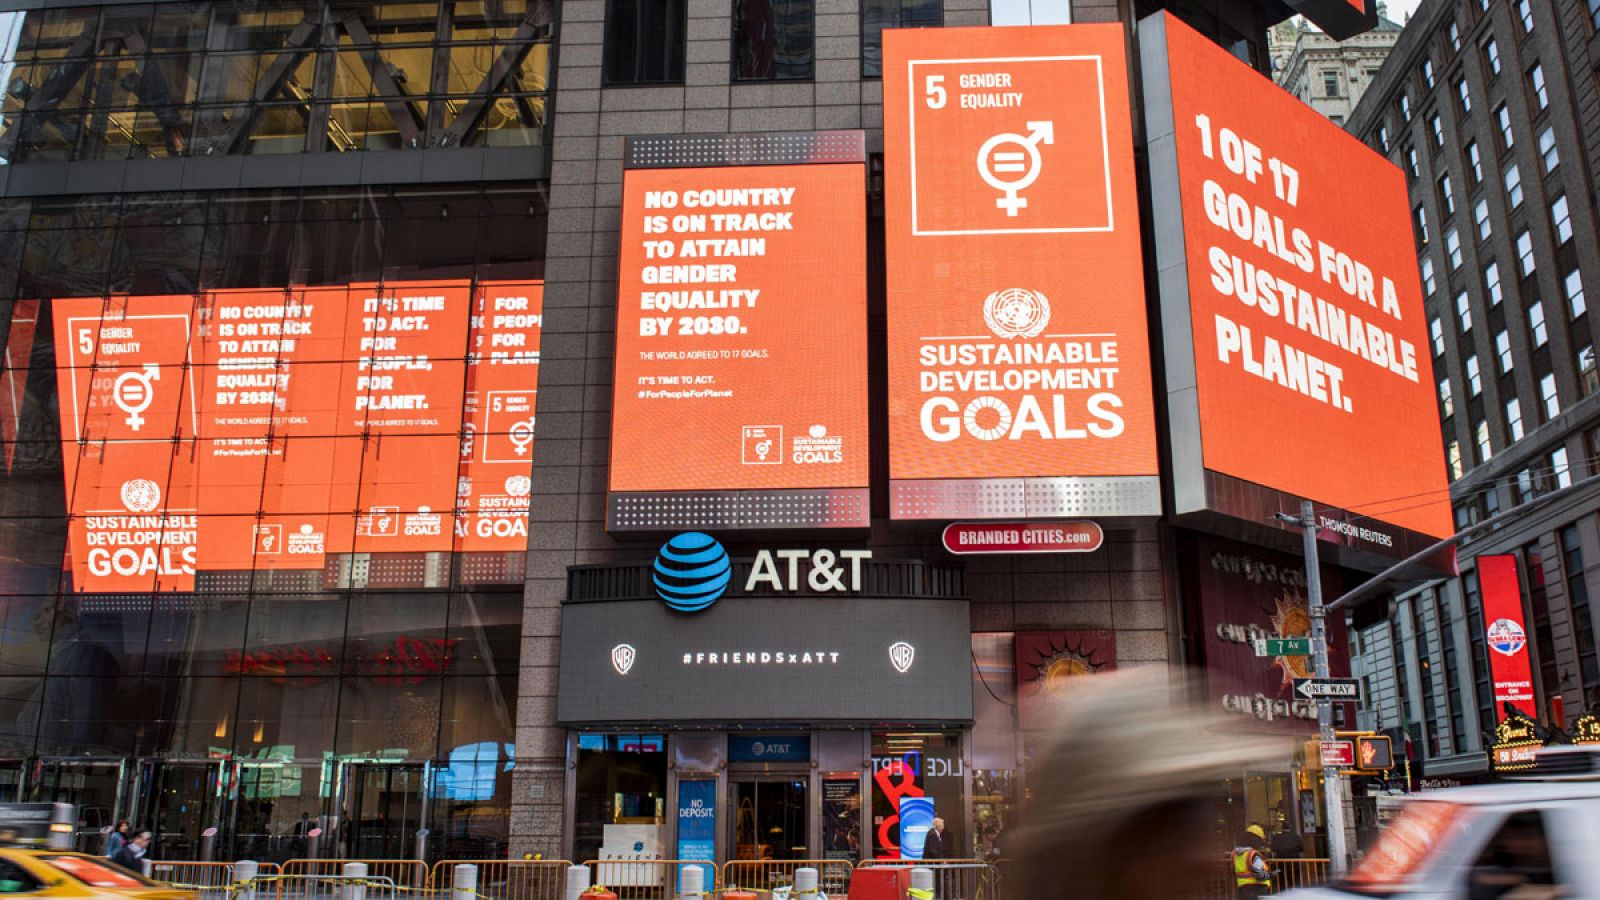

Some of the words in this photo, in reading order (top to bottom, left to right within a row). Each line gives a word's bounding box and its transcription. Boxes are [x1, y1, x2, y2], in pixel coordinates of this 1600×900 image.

[960, 73, 1012, 88] GENDER
[926, 75, 947, 109] 5
[960, 93, 1023, 109] EQUALITY
[1195, 113, 1213, 160] 1
[1219, 127, 1263, 184] OF
[1268, 156, 1299, 207] 17
[645, 191, 678, 208] NO
[683, 187, 795, 208] COUNTRY
[644, 216, 668, 233] IS
[672, 214, 706, 232] ON
[711, 212, 793, 231] TRACK
[643, 240, 675, 258] TO
[680, 238, 766, 257] ATTAIN
[1203, 179, 1314, 273] GOALS
[1318, 239, 1377, 308] FOR
[1382, 275, 1402, 321] A
[641, 264, 737, 284] GENDER
[364, 298, 398, 312] IT'S
[402, 296, 445, 311] TIME
[494, 297, 528, 311] FOR
[640, 289, 760, 312] EQUALITY
[220, 307, 241, 319] NO
[1208, 246, 1419, 384] SUSTAINABLE
[219, 323, 235, 336] IS
[237, 323, 258, 336] ON
[260, 322, 313, 335] TRACK
[363, 317, 387, 331] TO
[390, 316, 429, 330] ACT.
[639, 317, 673, 336] BY
[678, 316, 747, 335] 2030.
[80, 328, 93, 354] 5
[100, 328, 133, 339] GENDER
[492, 333, 525, 347] FOR
[102, 342, 140, 354] EQUALITY
[219, 341, 239, 352] TO
[241, 340, 295, 352] ATTAIN
[360, 336, 397, 351] FOR
[640, 351, 654, 360] THE
[656, 351, 683, 360] WORLD
[687, 350, 718, 359] AGREED
[720, 350, 730, 358] TO
[732, 350, 740, 358] 17
[919, 342, 1118, 366] SUSTAINABLE
[1214, 313, 1353, 413] PLANET.
[357, 376, 393, 391] FOR
[638, 376, 656, 385] IT'S
[658, 376, 680, 385] TIME
[681, 376, 693, 384] TO
[695, 375, 715, 384] ACT.
[920, 368, 1119, 392] DEVELOPMENT
[216, 392, 237, 404] BY
[638, 389, 733, 399] #ForPeopleForPlanet
[355, 395, 429, 410] PLANET.
[492, 397, 502, 412] 5
[920, 392, 1125, 442] GOALS
[793, 451, 843, 464] GOALS
[404, 526, 441, 536] GOALS
[959, 531, 1019, 545] BRANDED
[1022, 529, 1090, 545] CITIES.com
[1320, 516, 1359, 537] THOMSON
[1360, 527, 1393, 547] REUTERS
[288, 544, 324, 554] GOALS
[88, 547, 197, 576] GOALS
[744, 548, 872, 592] AT&T
[1277, 641, 1284, 653] 7
[683, 651, 840, 665] #FRIENDSxATT
[1305, 684, 1324, 693] ONE
[1329, 684, 1352, 693] WAY
[766, 744, 791, 753] AT&T
[690, 799, 703, 808] NO
[679, 807, 714, 818] DEPOSIT.
